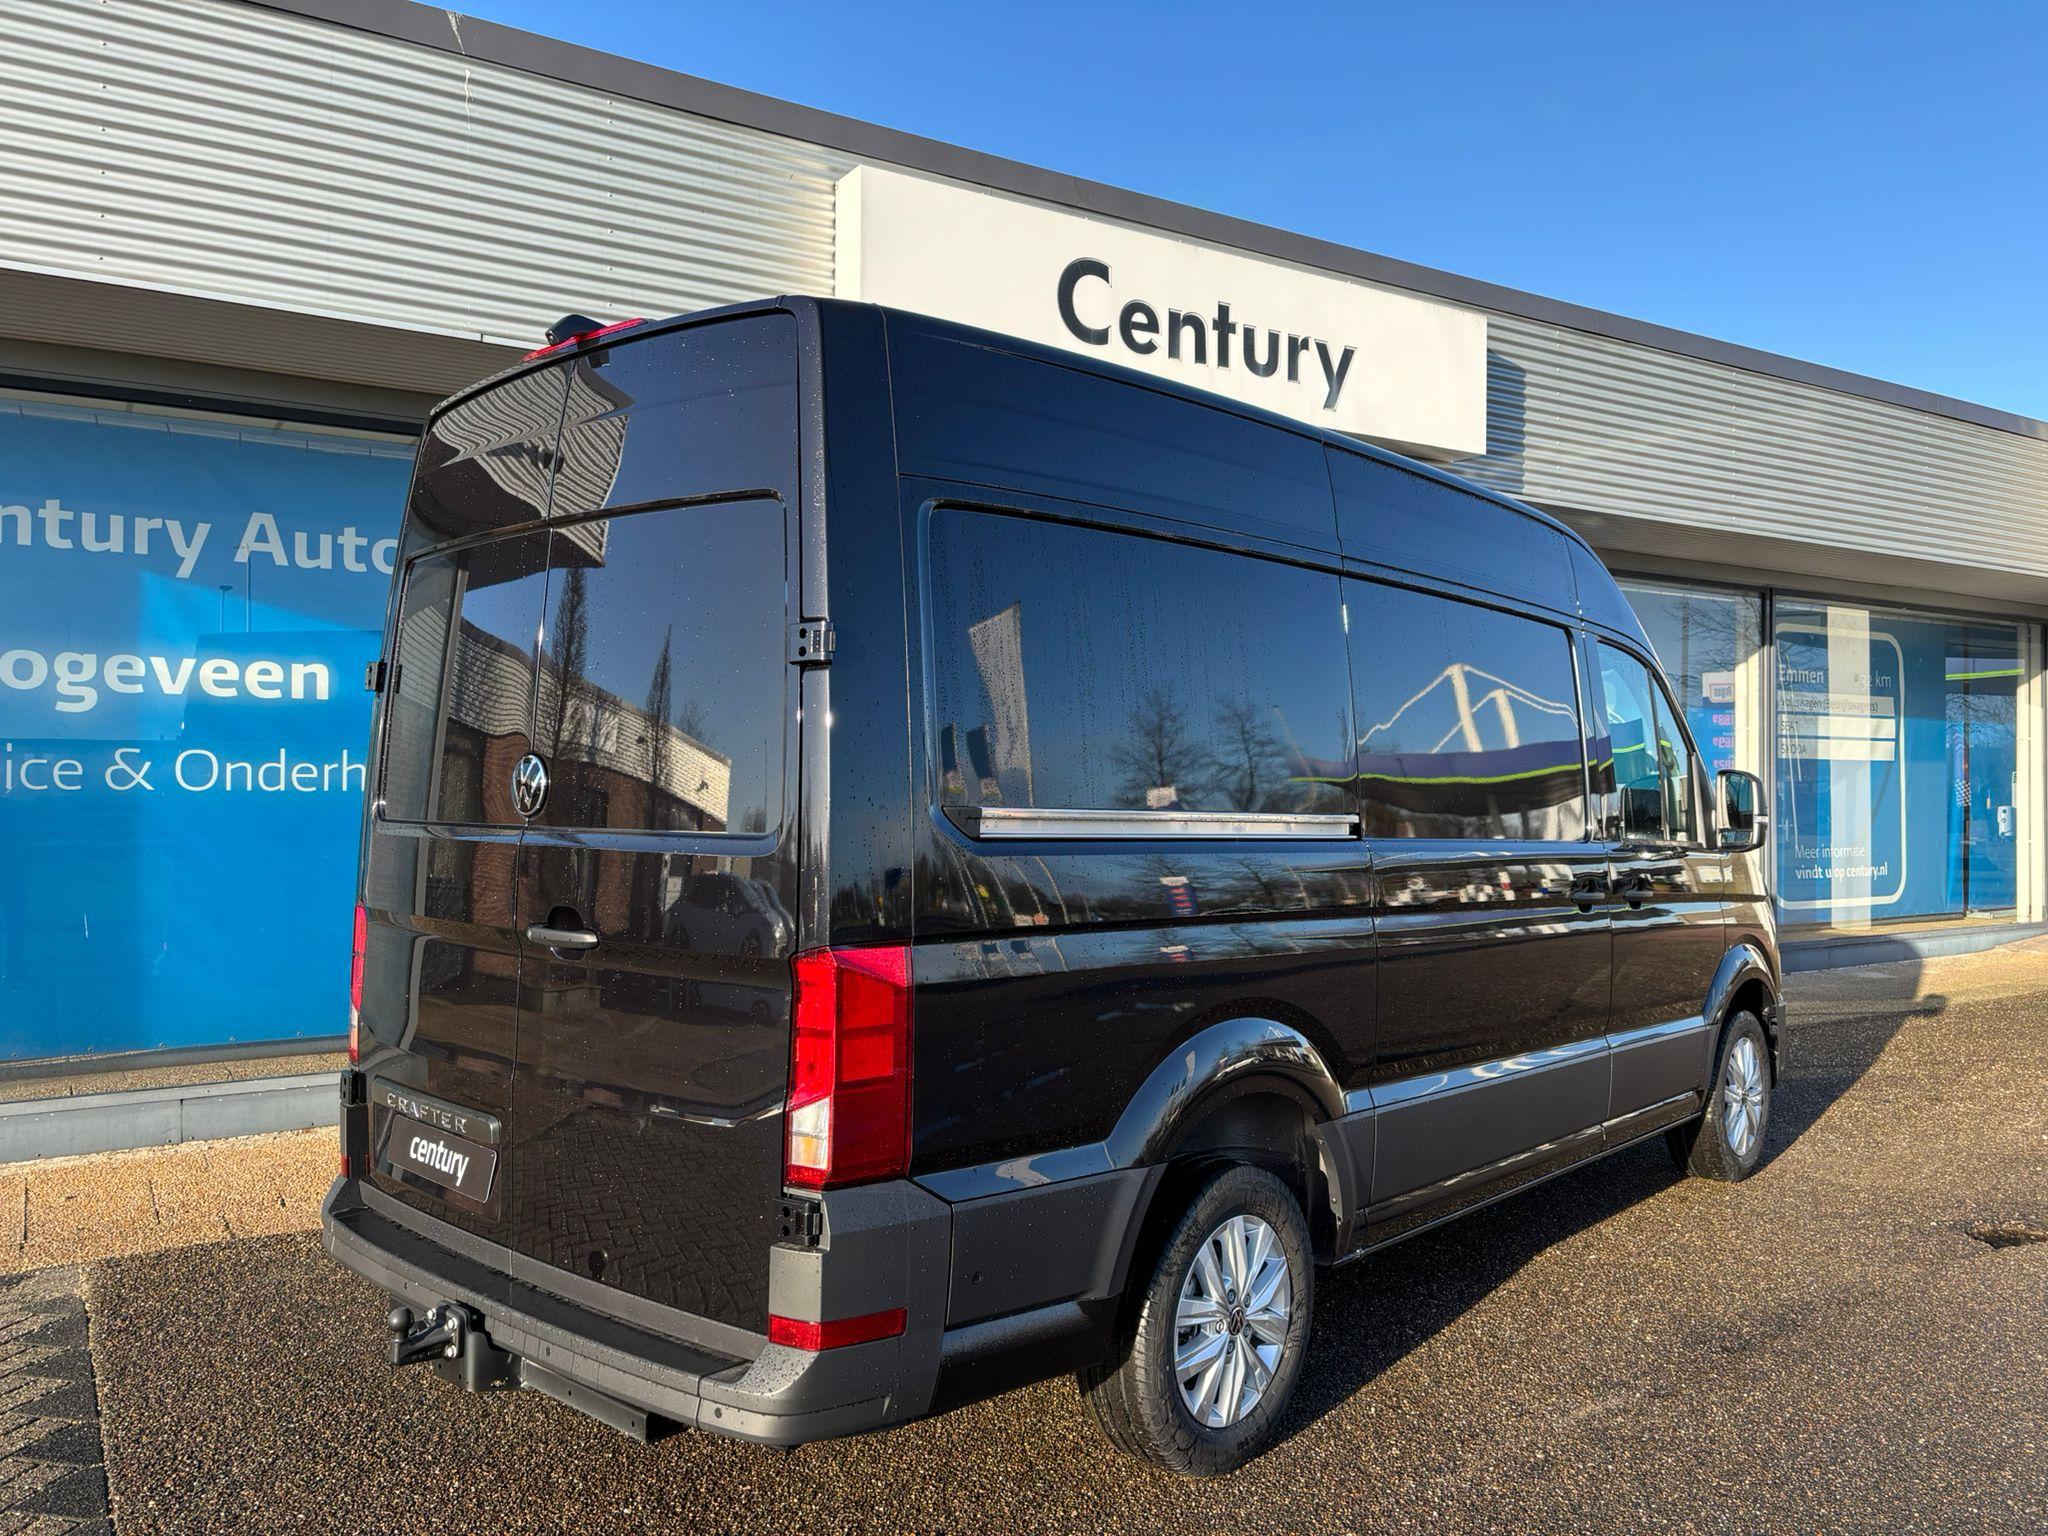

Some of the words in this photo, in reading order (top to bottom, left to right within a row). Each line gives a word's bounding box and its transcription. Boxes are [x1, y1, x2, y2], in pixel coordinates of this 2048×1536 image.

[1057, 256, 1358, 412] Century
[0, 498, 212, 579] ntury
[0, 649, 330, 713] ogeveen
[1779, 664, 1825, 685] Emmen
[1875, 669, 1892, 688] km
[6, 742, 84, 792] ice
[104, 747, 155, 792] &
[174, 747, 367, 792] Onderh
[1794, 844, 1820, 859] Meer
[1821, 843, 1866, 859] informatie
[1795, 864, 1824, 880] vindt
[1825, 868, 1832, 879] u
[1834, 866, 1845, 882] op
[1846, 861, 1888, 880] century.nl
[386, 1091, 469, 1134] CRAFTER
[409, 1135, 470, 1187] century
